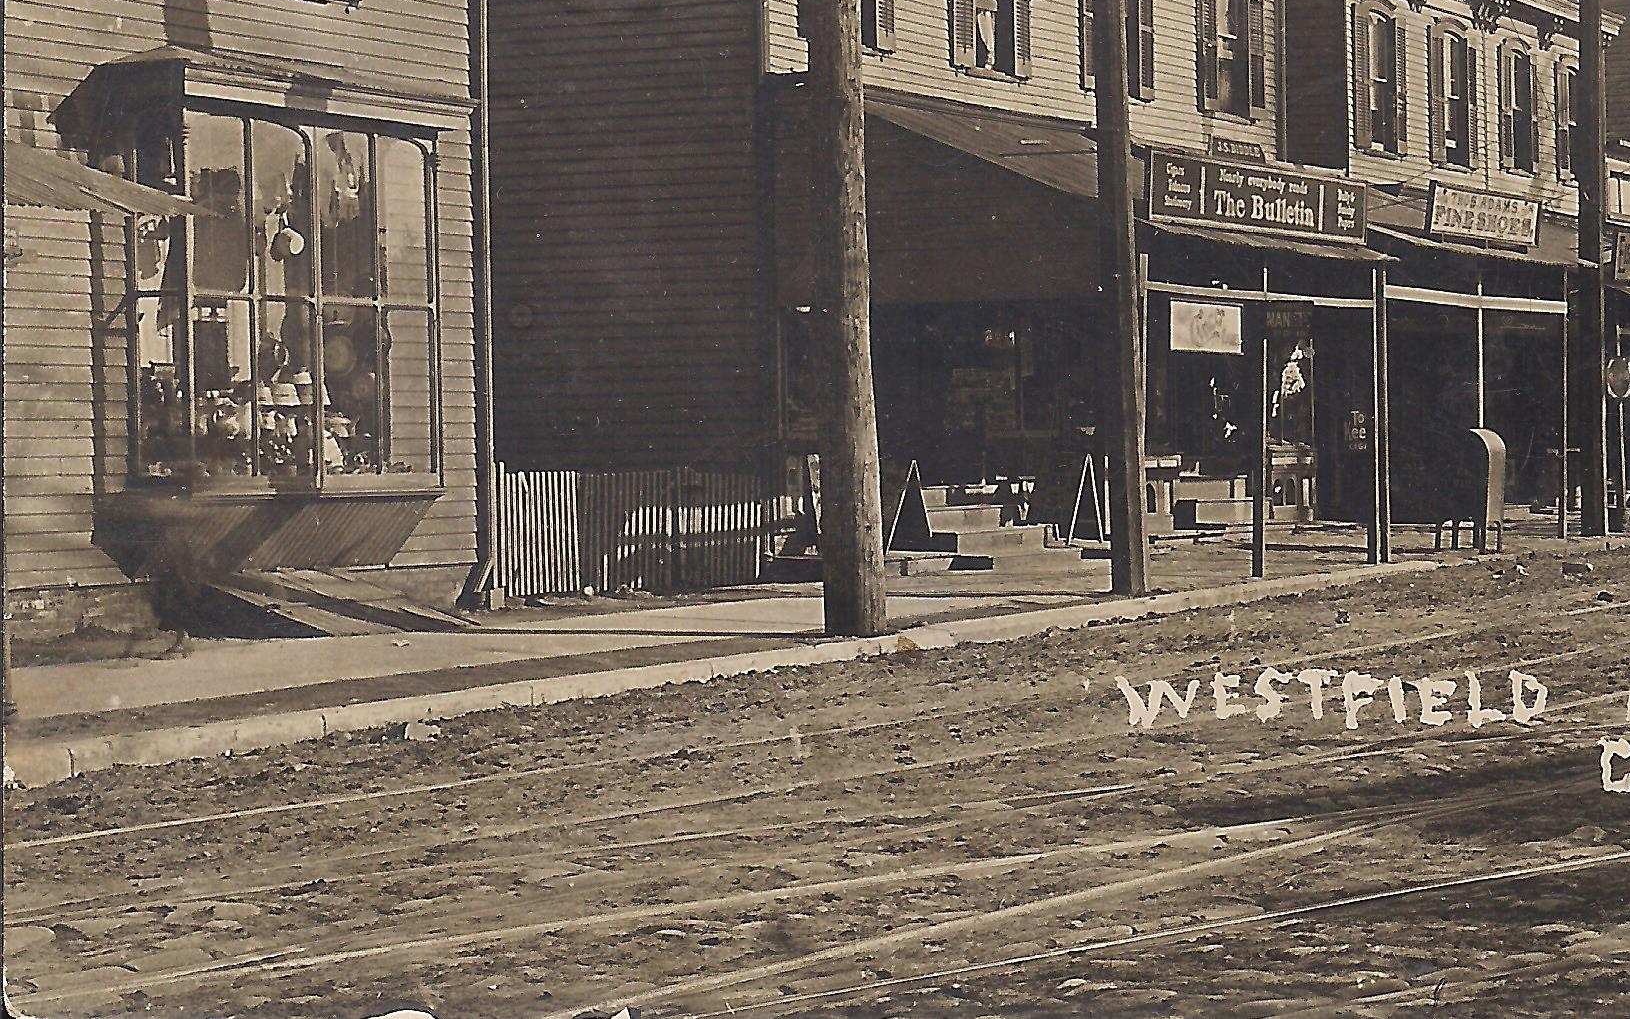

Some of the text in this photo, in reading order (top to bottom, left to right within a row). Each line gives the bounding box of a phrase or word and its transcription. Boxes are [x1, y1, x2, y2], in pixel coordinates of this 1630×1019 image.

[1219, 169, 1308, 195] Nearly everybody reads
[1213, 190, 1315, 227] The Bulletin
[1433, 205, 1475, 230] FINE
